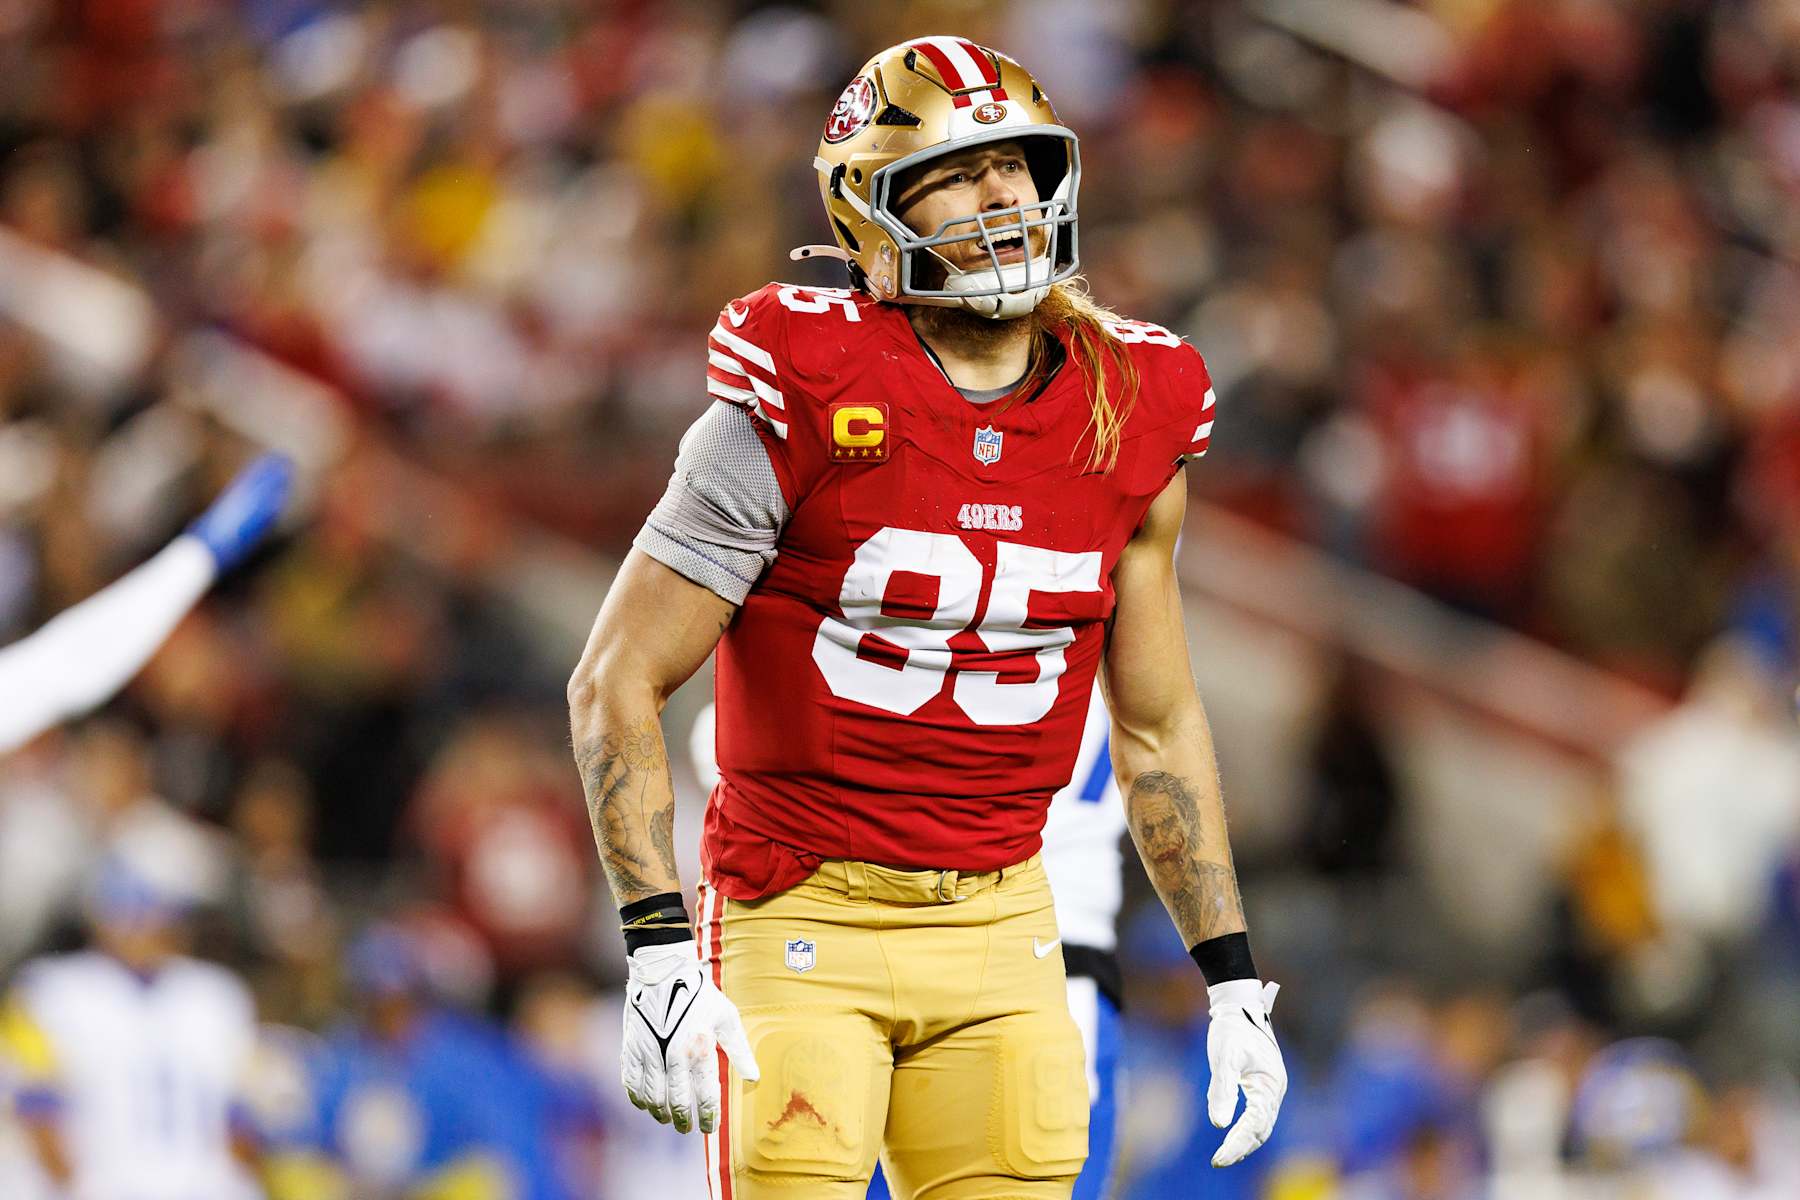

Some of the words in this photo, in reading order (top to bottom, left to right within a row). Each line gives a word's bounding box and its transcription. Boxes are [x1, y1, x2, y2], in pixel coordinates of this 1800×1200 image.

[833, 406, 885, 447] C
[978, 442, 998, 459] NFL
[957, 503, 1024, 531] 49ERS
[812, 526, 1104, 726] 85
[645, 911, 663, 921] Team
